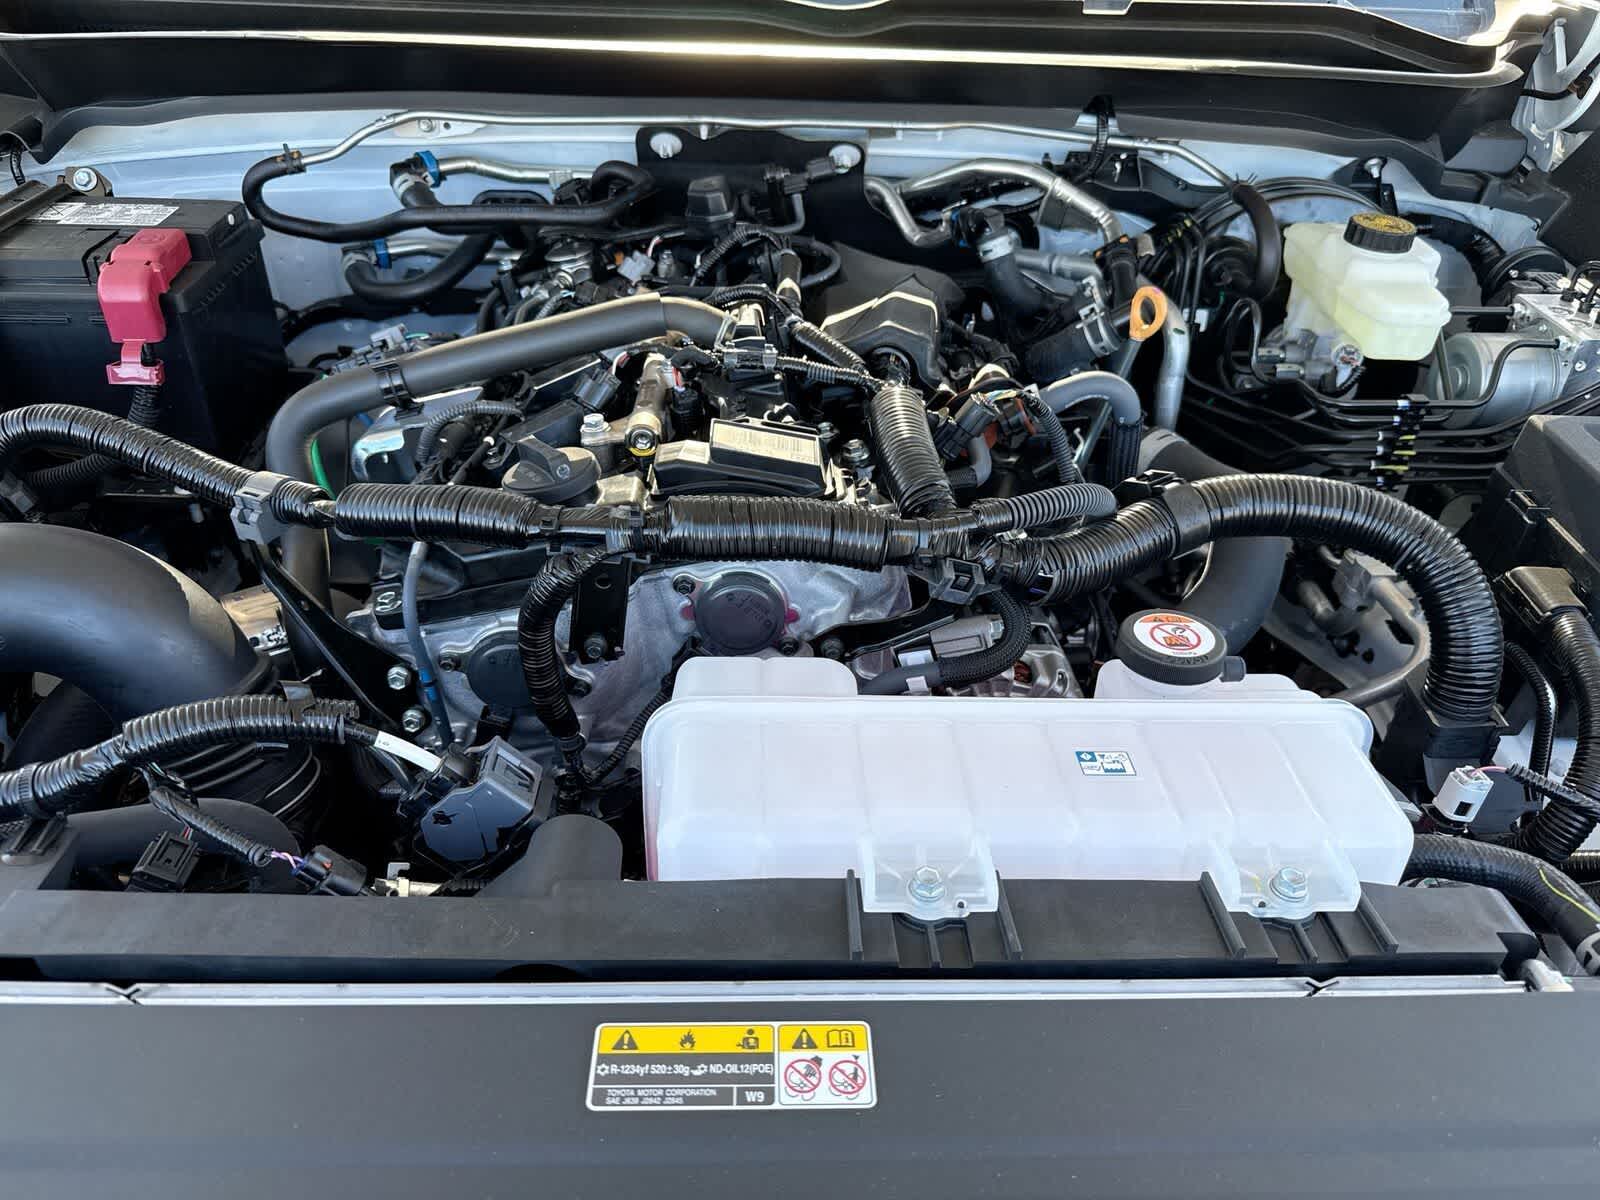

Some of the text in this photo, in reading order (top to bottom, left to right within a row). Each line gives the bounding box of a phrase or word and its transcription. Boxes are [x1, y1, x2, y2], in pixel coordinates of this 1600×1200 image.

[610, 1063, 649, 1076] R-1234yf
[607, 1087, 717, 1097] TOYOTA MOTOR CORPORATION
[744, 1090, 765, 1103] W9
